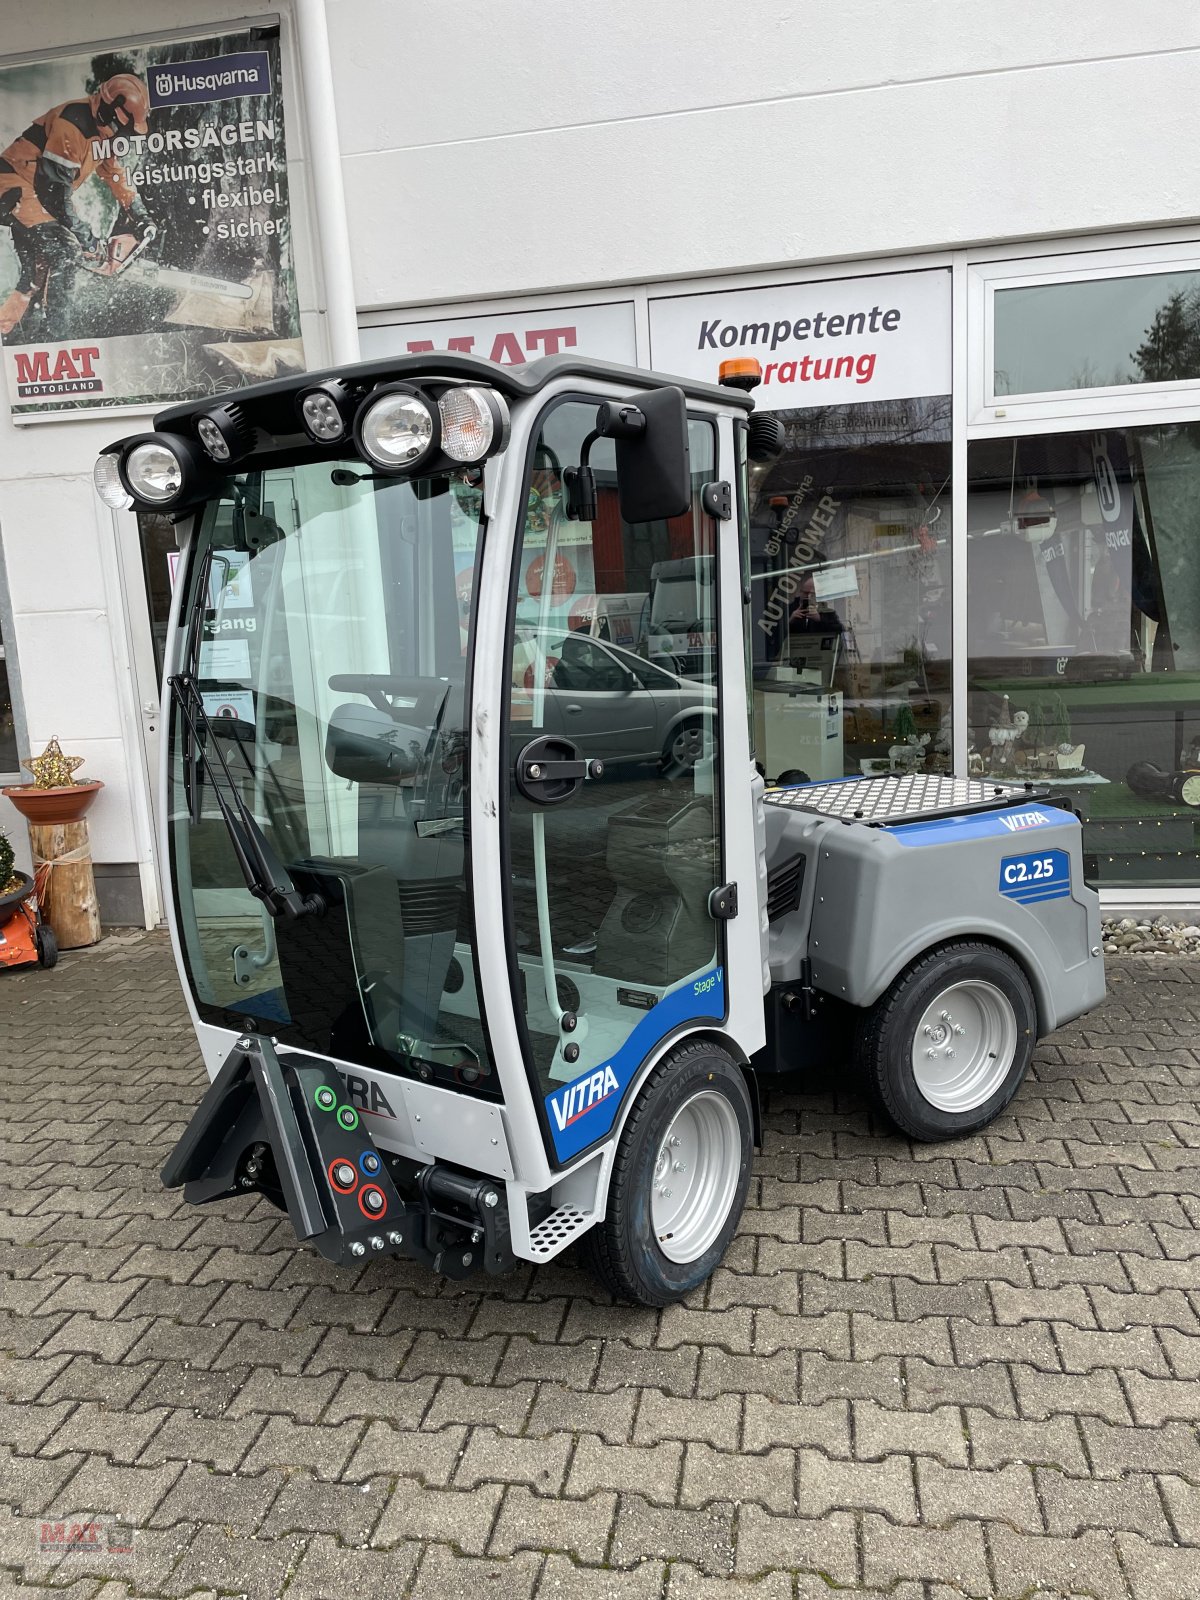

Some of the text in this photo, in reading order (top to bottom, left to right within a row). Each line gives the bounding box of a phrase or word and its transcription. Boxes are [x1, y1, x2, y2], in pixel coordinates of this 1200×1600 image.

[174, 67, 258, 91] Husqvarna
[92, 120, 275, 161] MOTORSÄGEN
[126, 152, 278, 186] leistungsstark
[202, 183, 280, 209] flexibel
[217, 216, 282, 239] sicher
[698, 306, 901, 351] Kompetente
[407, 326, 577, 366] AT
[14, 347, 100, 383] MAT
[760, 353, 877, 385] ratung
[25, 381, 94, 395] MOTORLAND
[772, 474, 813, 541] Husqvarna
[204, 617, 256, 634] gang
[998, 811, 1050, 832] VITRA
[1004, 858, 1054, 884] C2.25
[694, 969, 722, 996] Stage V
[338, 1072, 397, 1119] RA
[551, 1065, 620, 1132] VITRA
